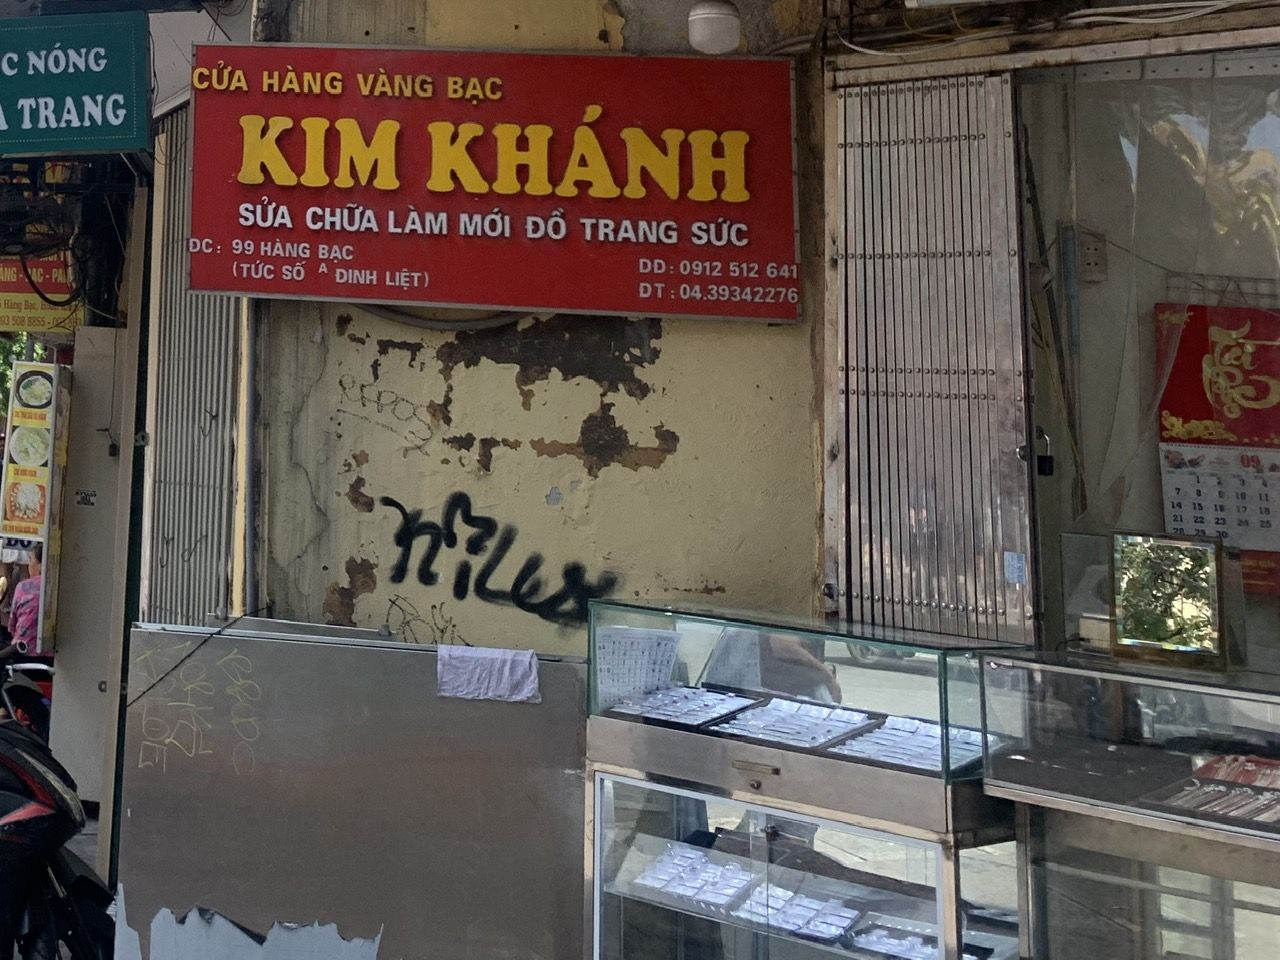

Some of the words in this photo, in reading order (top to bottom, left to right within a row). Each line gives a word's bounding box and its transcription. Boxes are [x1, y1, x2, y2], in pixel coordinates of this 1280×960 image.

[26, 42, 108, 75] NÓNG
[192, 60, 248, 91] CỬA
[263, 66, 343, 95] HÀNG
[357, 68, 433, 97] VÀNG
[447, 76, 503, 105] BẠC
[17, 94, 127, 131] TRANG
[237, 114, 400, 190] KIM
[426, 104, 751, 202] KHÁNH
[238, 196, 293, 229] SỬA
[306, 203, 379, 233] CHỮA
[388, 206, 447, 235] LÀM
[459, 208, 511, 237] MỚI
[525, 208, 567, 239] ĐỒ
[579, 218, 678, 244] TRANG
[691, 217, 749, 246] SỨC
[232, 239, 254, 254] 99
[260, 238, 310, 258] HÀNG
[318, 244, 354, 263] BẠC
[282, 260, 305, 281] SỐ
[335, 270, 377, 285] ĐINH
[680, 260, 722, 276] 0912
[729, 262, 759, 277] 512
[766, 263, 798, 279] 641
[680, 283, 798, 303] 04.39342276
[1175, 487, 1180, 495] 7
[1259, 493, 1268, 501] 11
[1171, 501, 1182, 509] 14
[1193, 502, 1203, 510] 15
[1214, 504, 1225, 512] 16
[1236, 505, 1247, 513] 17
[1172, 514, 1183, 522] 21
[1193, 515, 1205, 524] 22
[1215, 517, 1226, 525] 23
